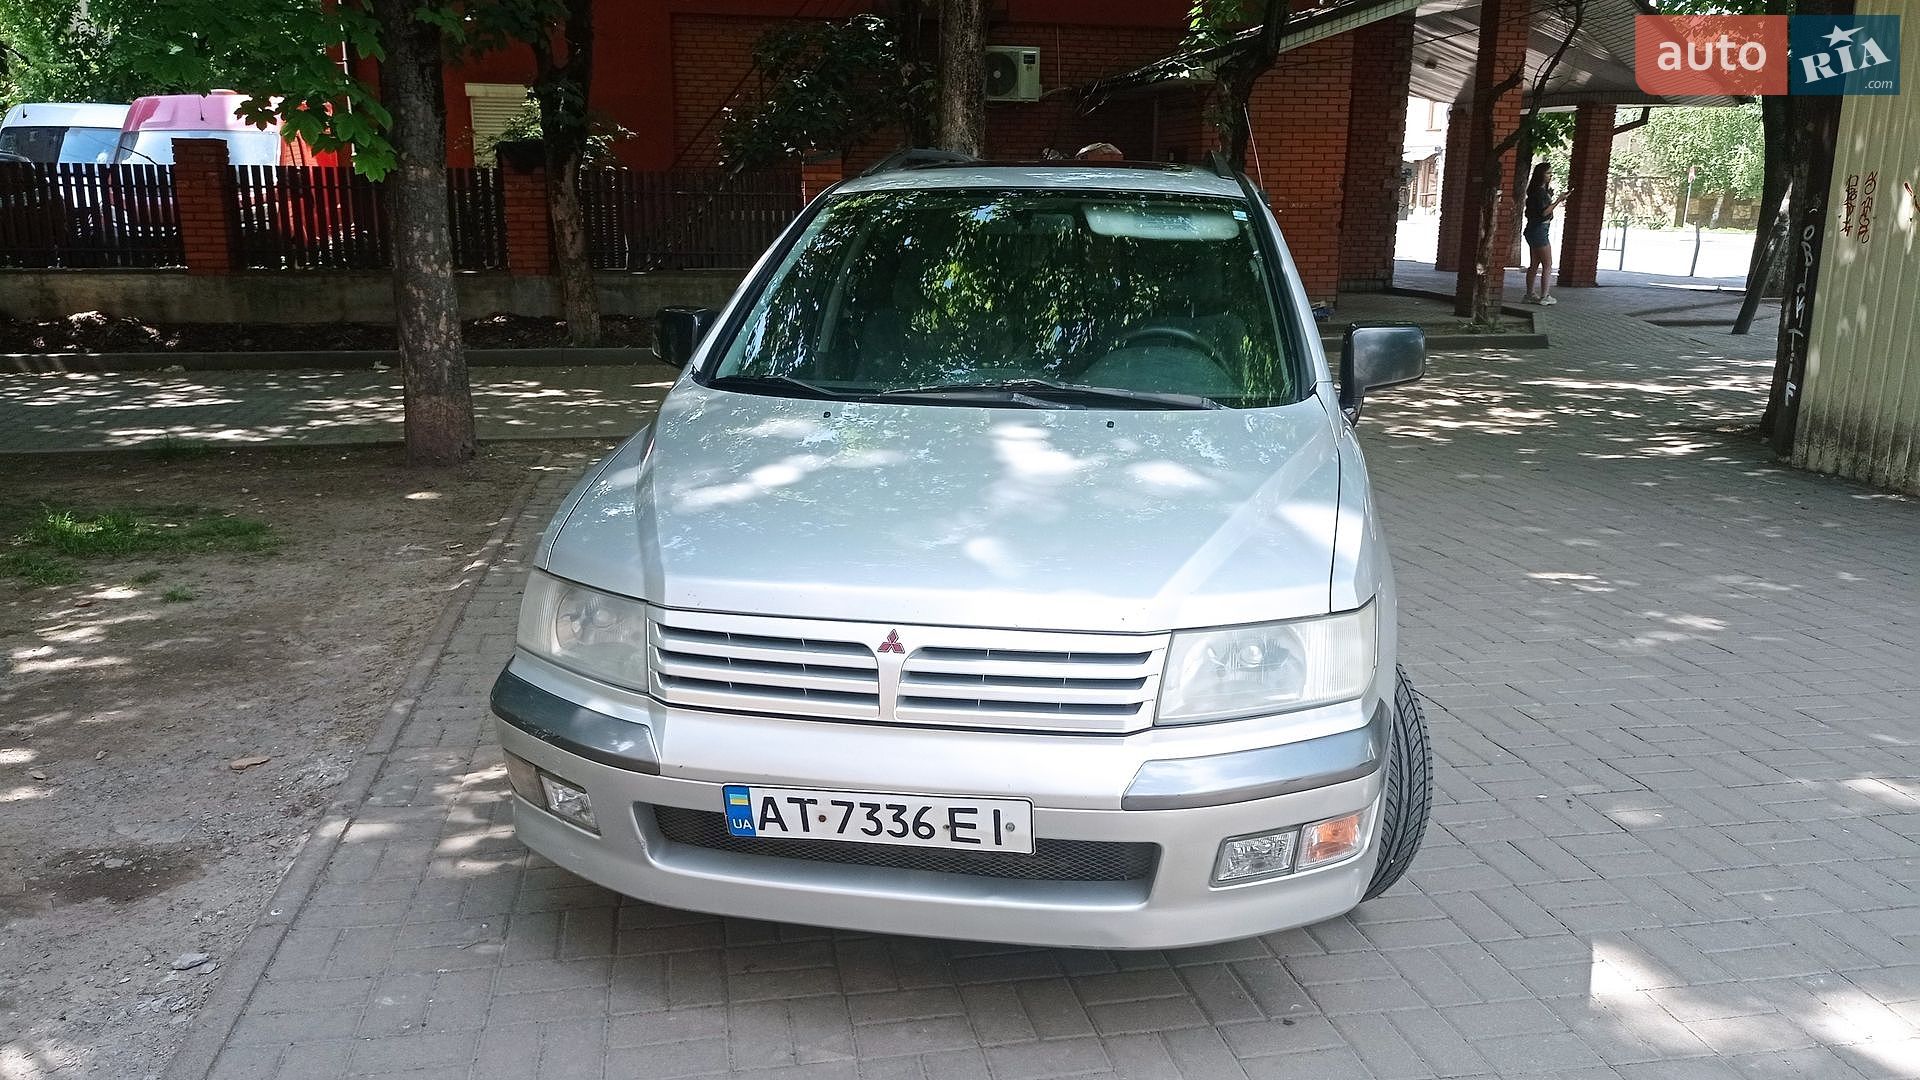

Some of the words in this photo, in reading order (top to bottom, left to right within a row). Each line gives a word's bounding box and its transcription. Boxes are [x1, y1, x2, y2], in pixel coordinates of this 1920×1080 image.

[733, 818, 753, 830] UA
[758, 796, 818, 833] AT
[830, 799, 936, 840] 7336
[948, 807, 1002, 846] EI
